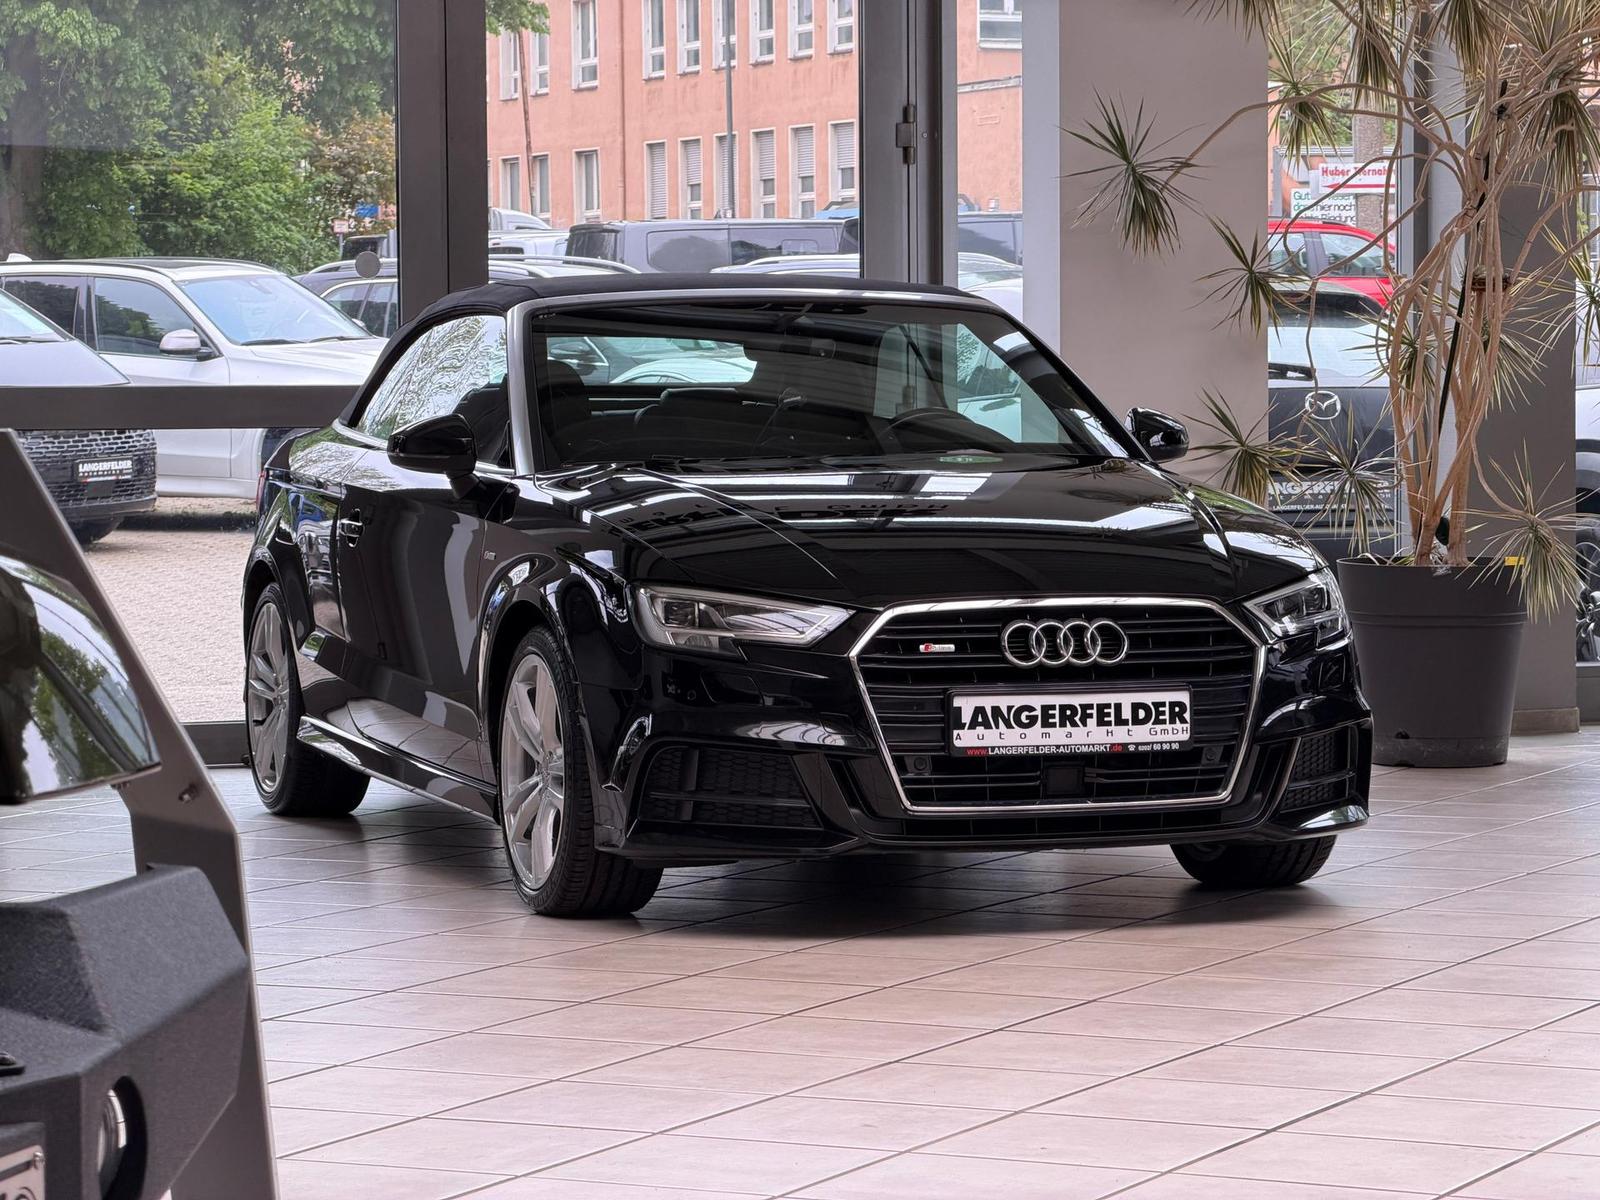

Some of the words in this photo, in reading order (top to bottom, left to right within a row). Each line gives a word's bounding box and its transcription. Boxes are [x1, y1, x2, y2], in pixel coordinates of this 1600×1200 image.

[1321, 166, 1351, 177] Huber
[1334, 202, 1356, 211] noch
[78, 460, 133, 473] LANGERFELDER
[953, 701, 1190, 731] LANGERFELDER
[1149, 726, 1189, 736] GmbH
[966, 743, 1123, 756] www.LANGERFELDER-AUTOMARKT.de
[1171, 742, 1179, 750] 90
